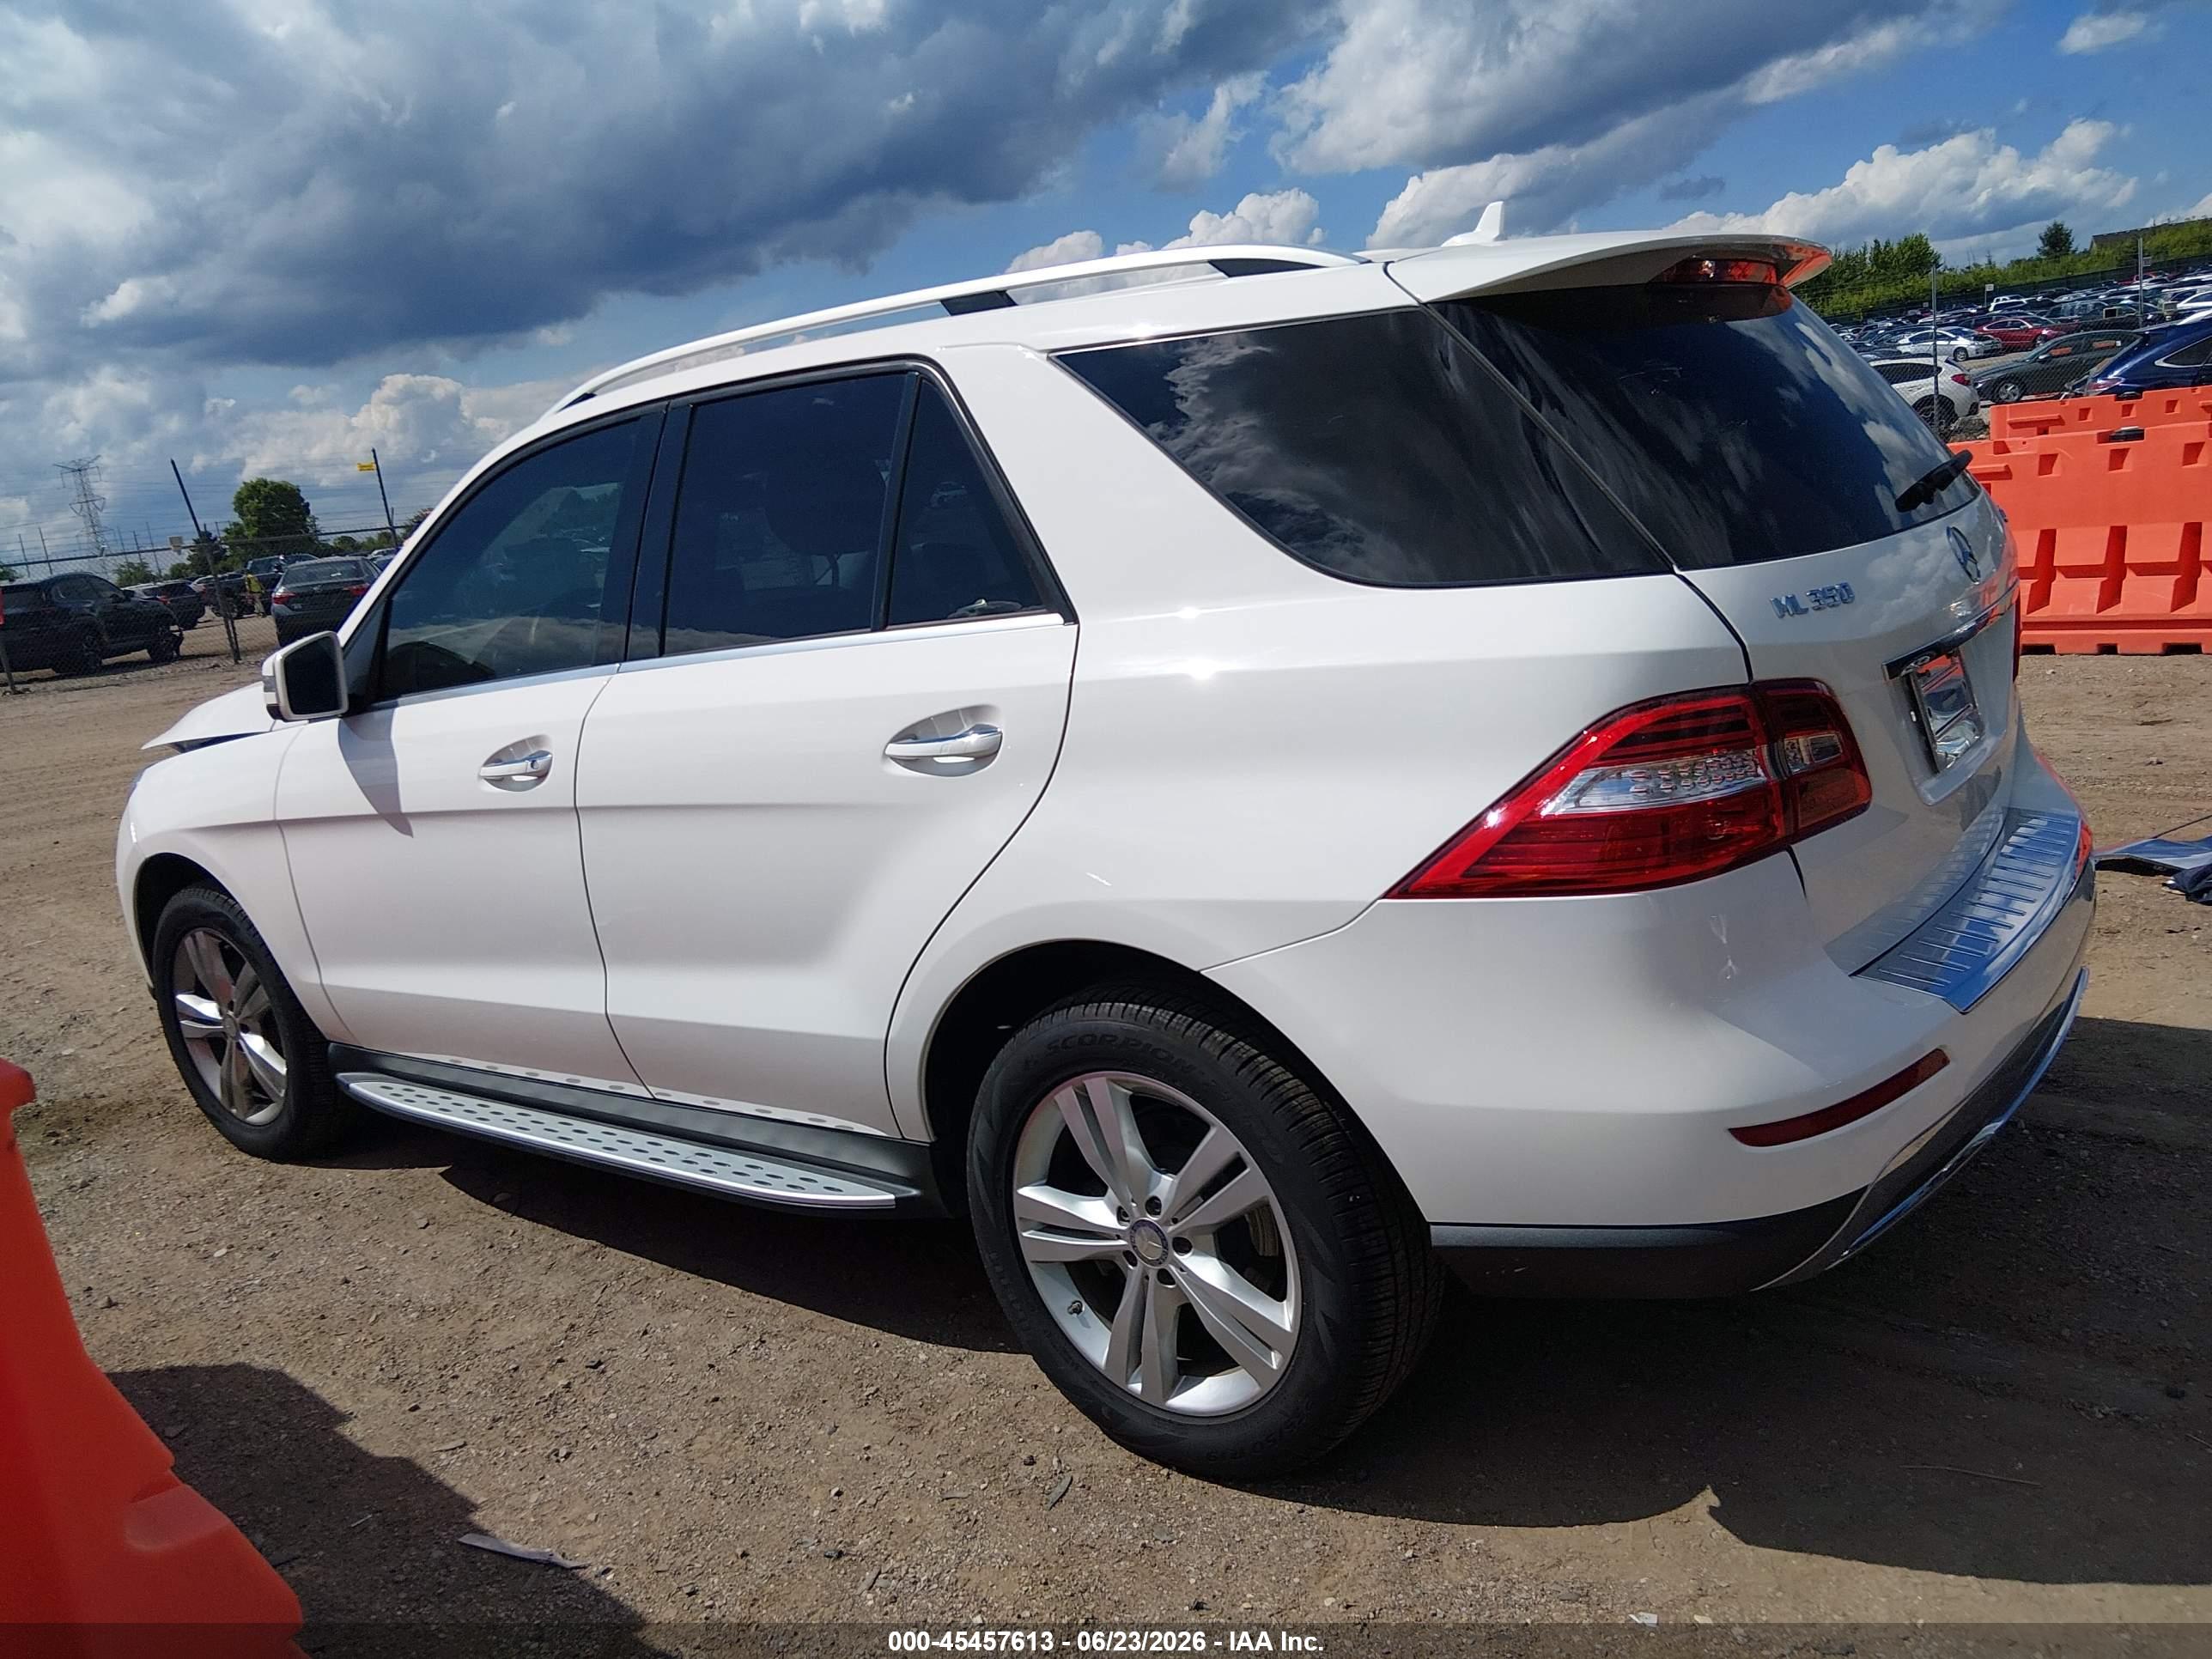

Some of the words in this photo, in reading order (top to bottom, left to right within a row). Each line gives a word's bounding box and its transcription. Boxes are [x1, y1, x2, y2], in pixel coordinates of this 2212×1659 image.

[1769, 593, 1808, 618] ML
[1806, 582, 1855, 611] 350
[1046, 1033, 1198, 1073] SCORPION
